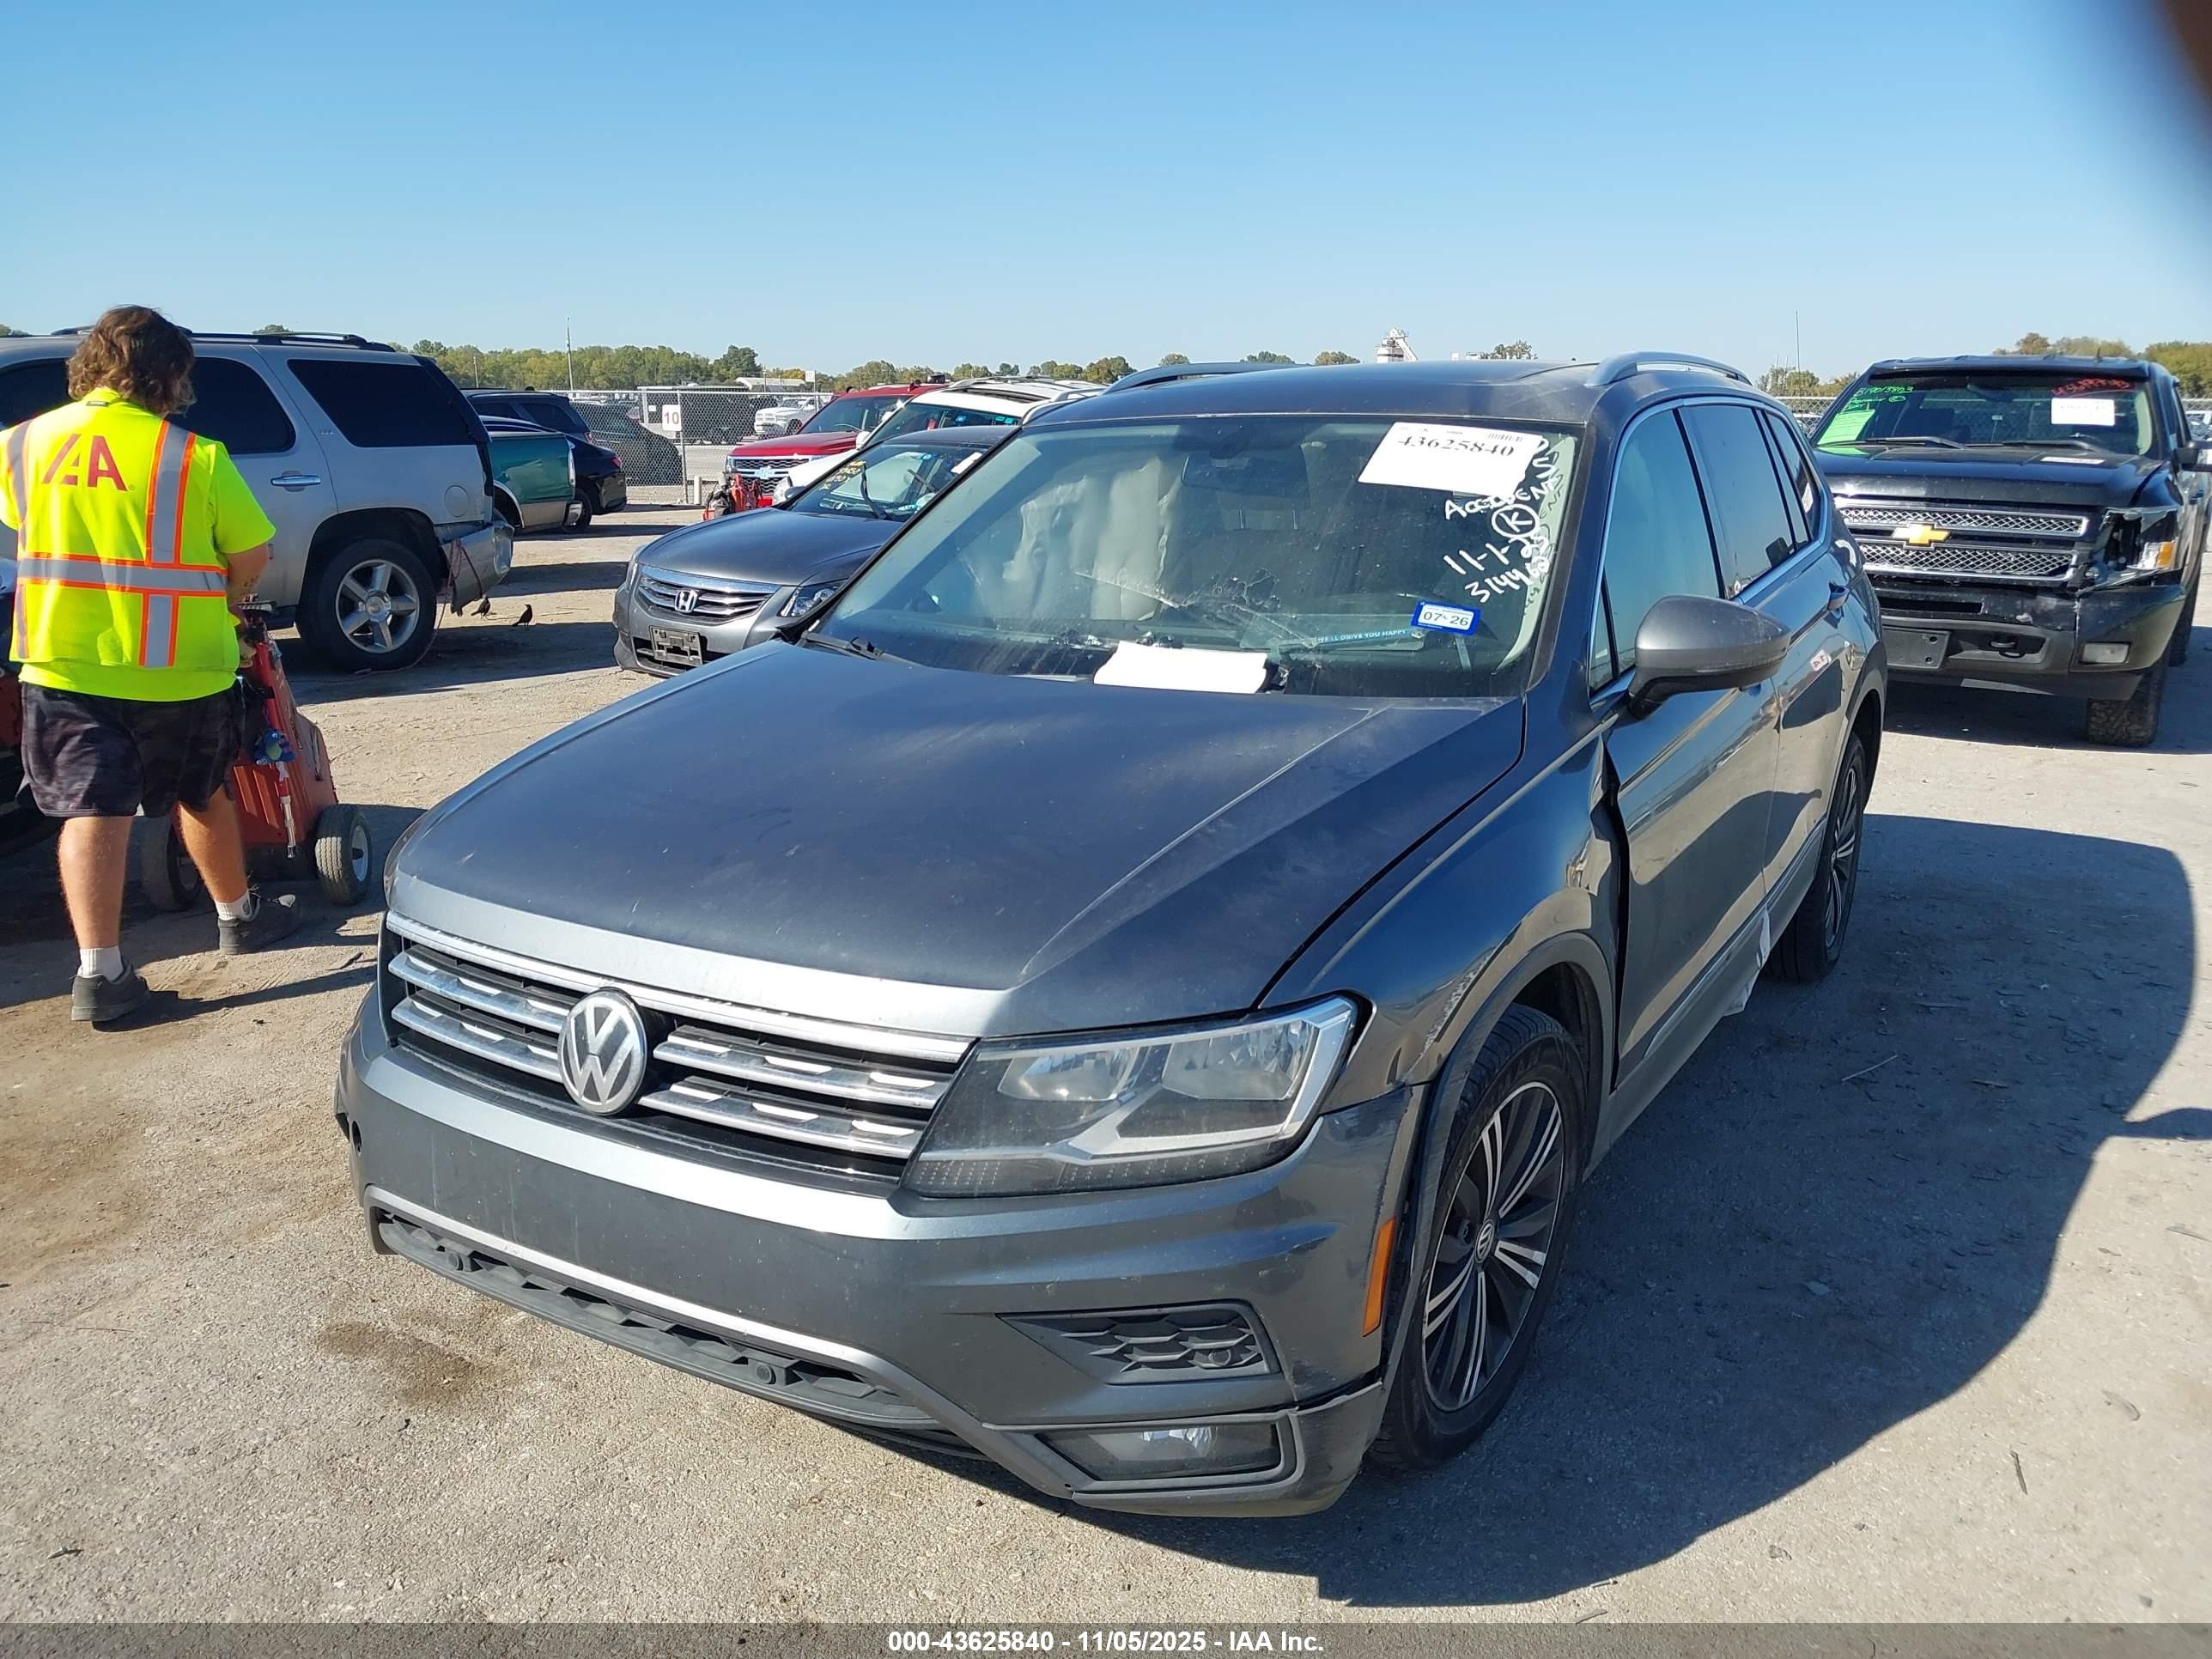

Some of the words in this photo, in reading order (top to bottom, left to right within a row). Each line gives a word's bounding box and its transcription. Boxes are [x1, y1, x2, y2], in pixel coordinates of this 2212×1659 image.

[664, 411, 679, 424] 10
[1398, 435, 1515, 456] 43625840
[1340, 633, 1364, 641] DRIVE
